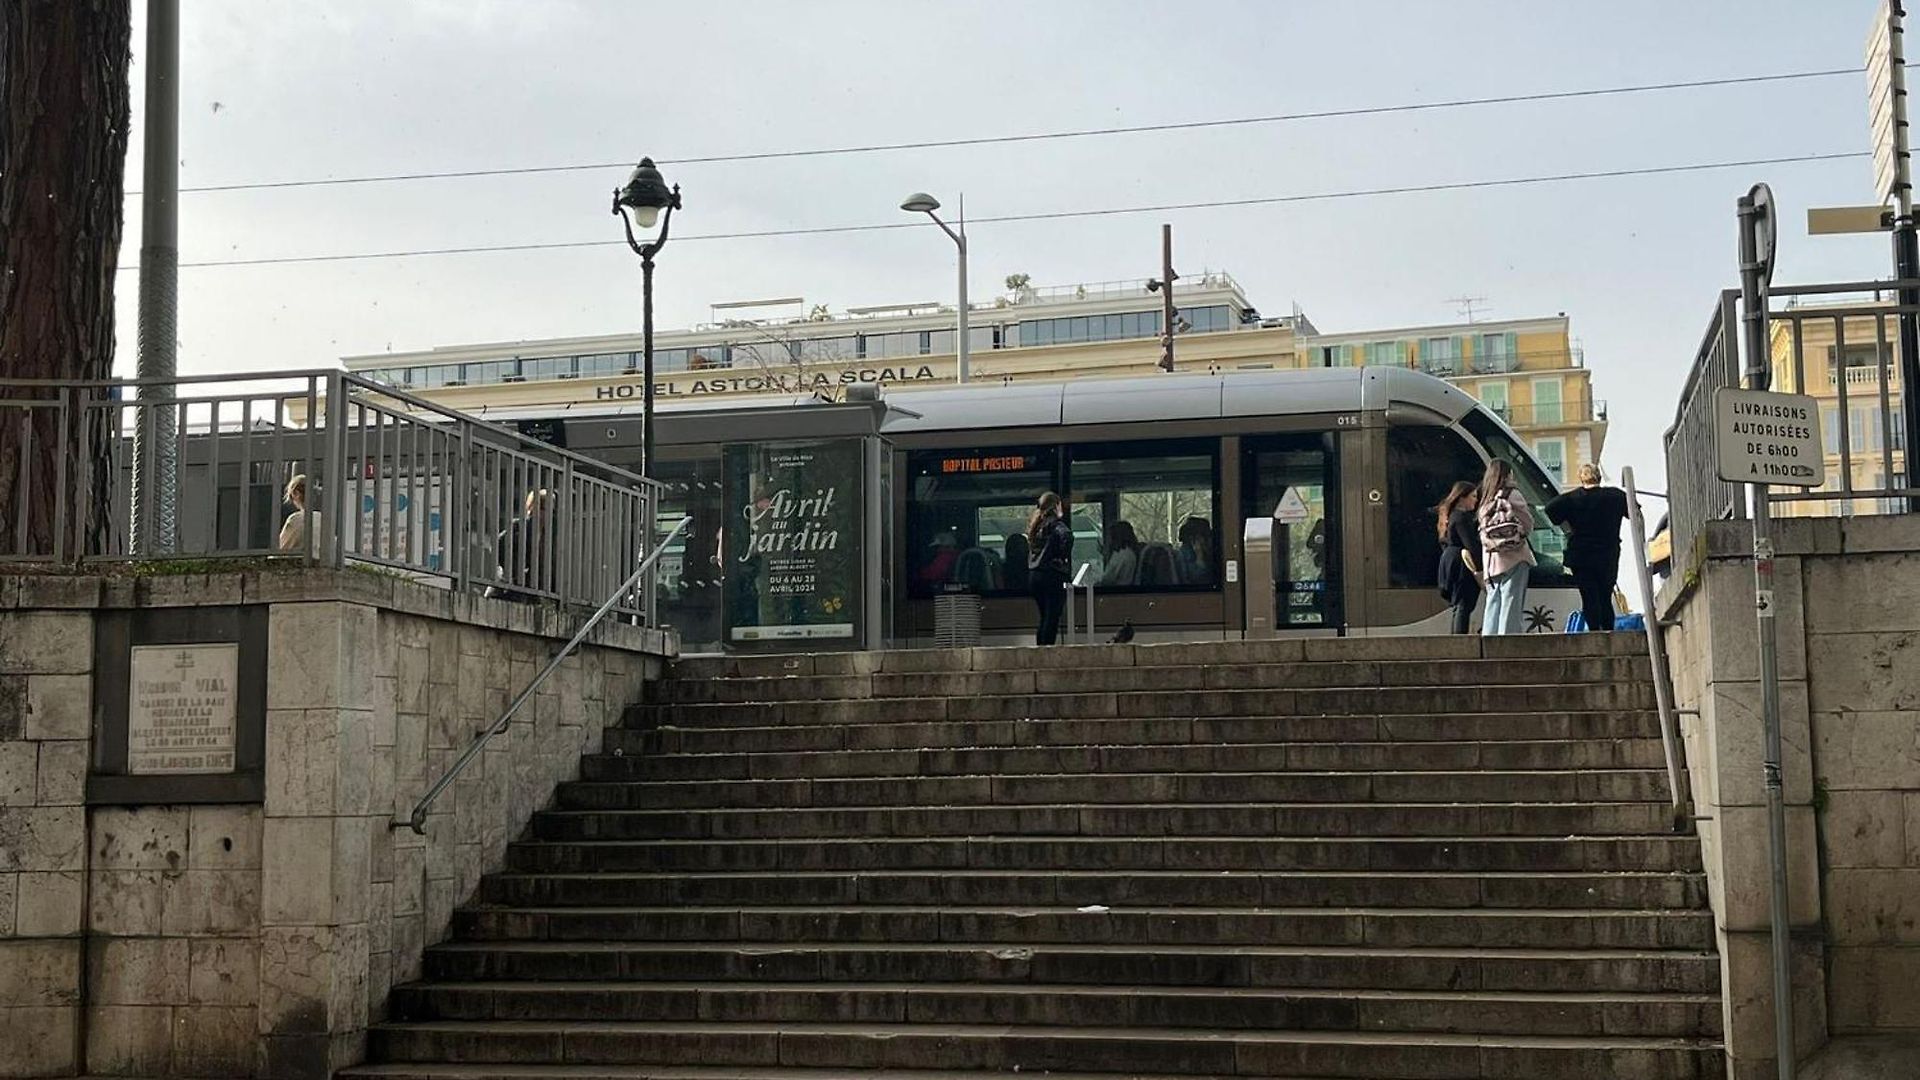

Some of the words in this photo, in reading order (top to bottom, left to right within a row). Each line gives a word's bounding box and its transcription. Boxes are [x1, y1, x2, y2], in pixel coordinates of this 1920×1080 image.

[839, 365, 934, 384] SCALA
[1733, 402, 1808, 420] LIVRAISONS
[1337, 416, 1358, 426] 015
[1733, 422, 1810, 439] AUTORISÉES
[1747, 443, 1762, 455] DE
[1768, 445, 1799, 458] 6h00
[983, 456, 1025, 471] PASTEUR
[1750, 463, 1758, 475] A
[1763, 464, 1798, 477] 11h00
[743, 487, 836, 520] Avril
[771, 520, 788, 530] au
[738, 522, 838, 562] jardin
[770, 576, 782, 584] DU
[791, 575, 804, 584] AU
[770, 584, 794, 593] AVRIL
[795, 583, 815, 592] 2024
